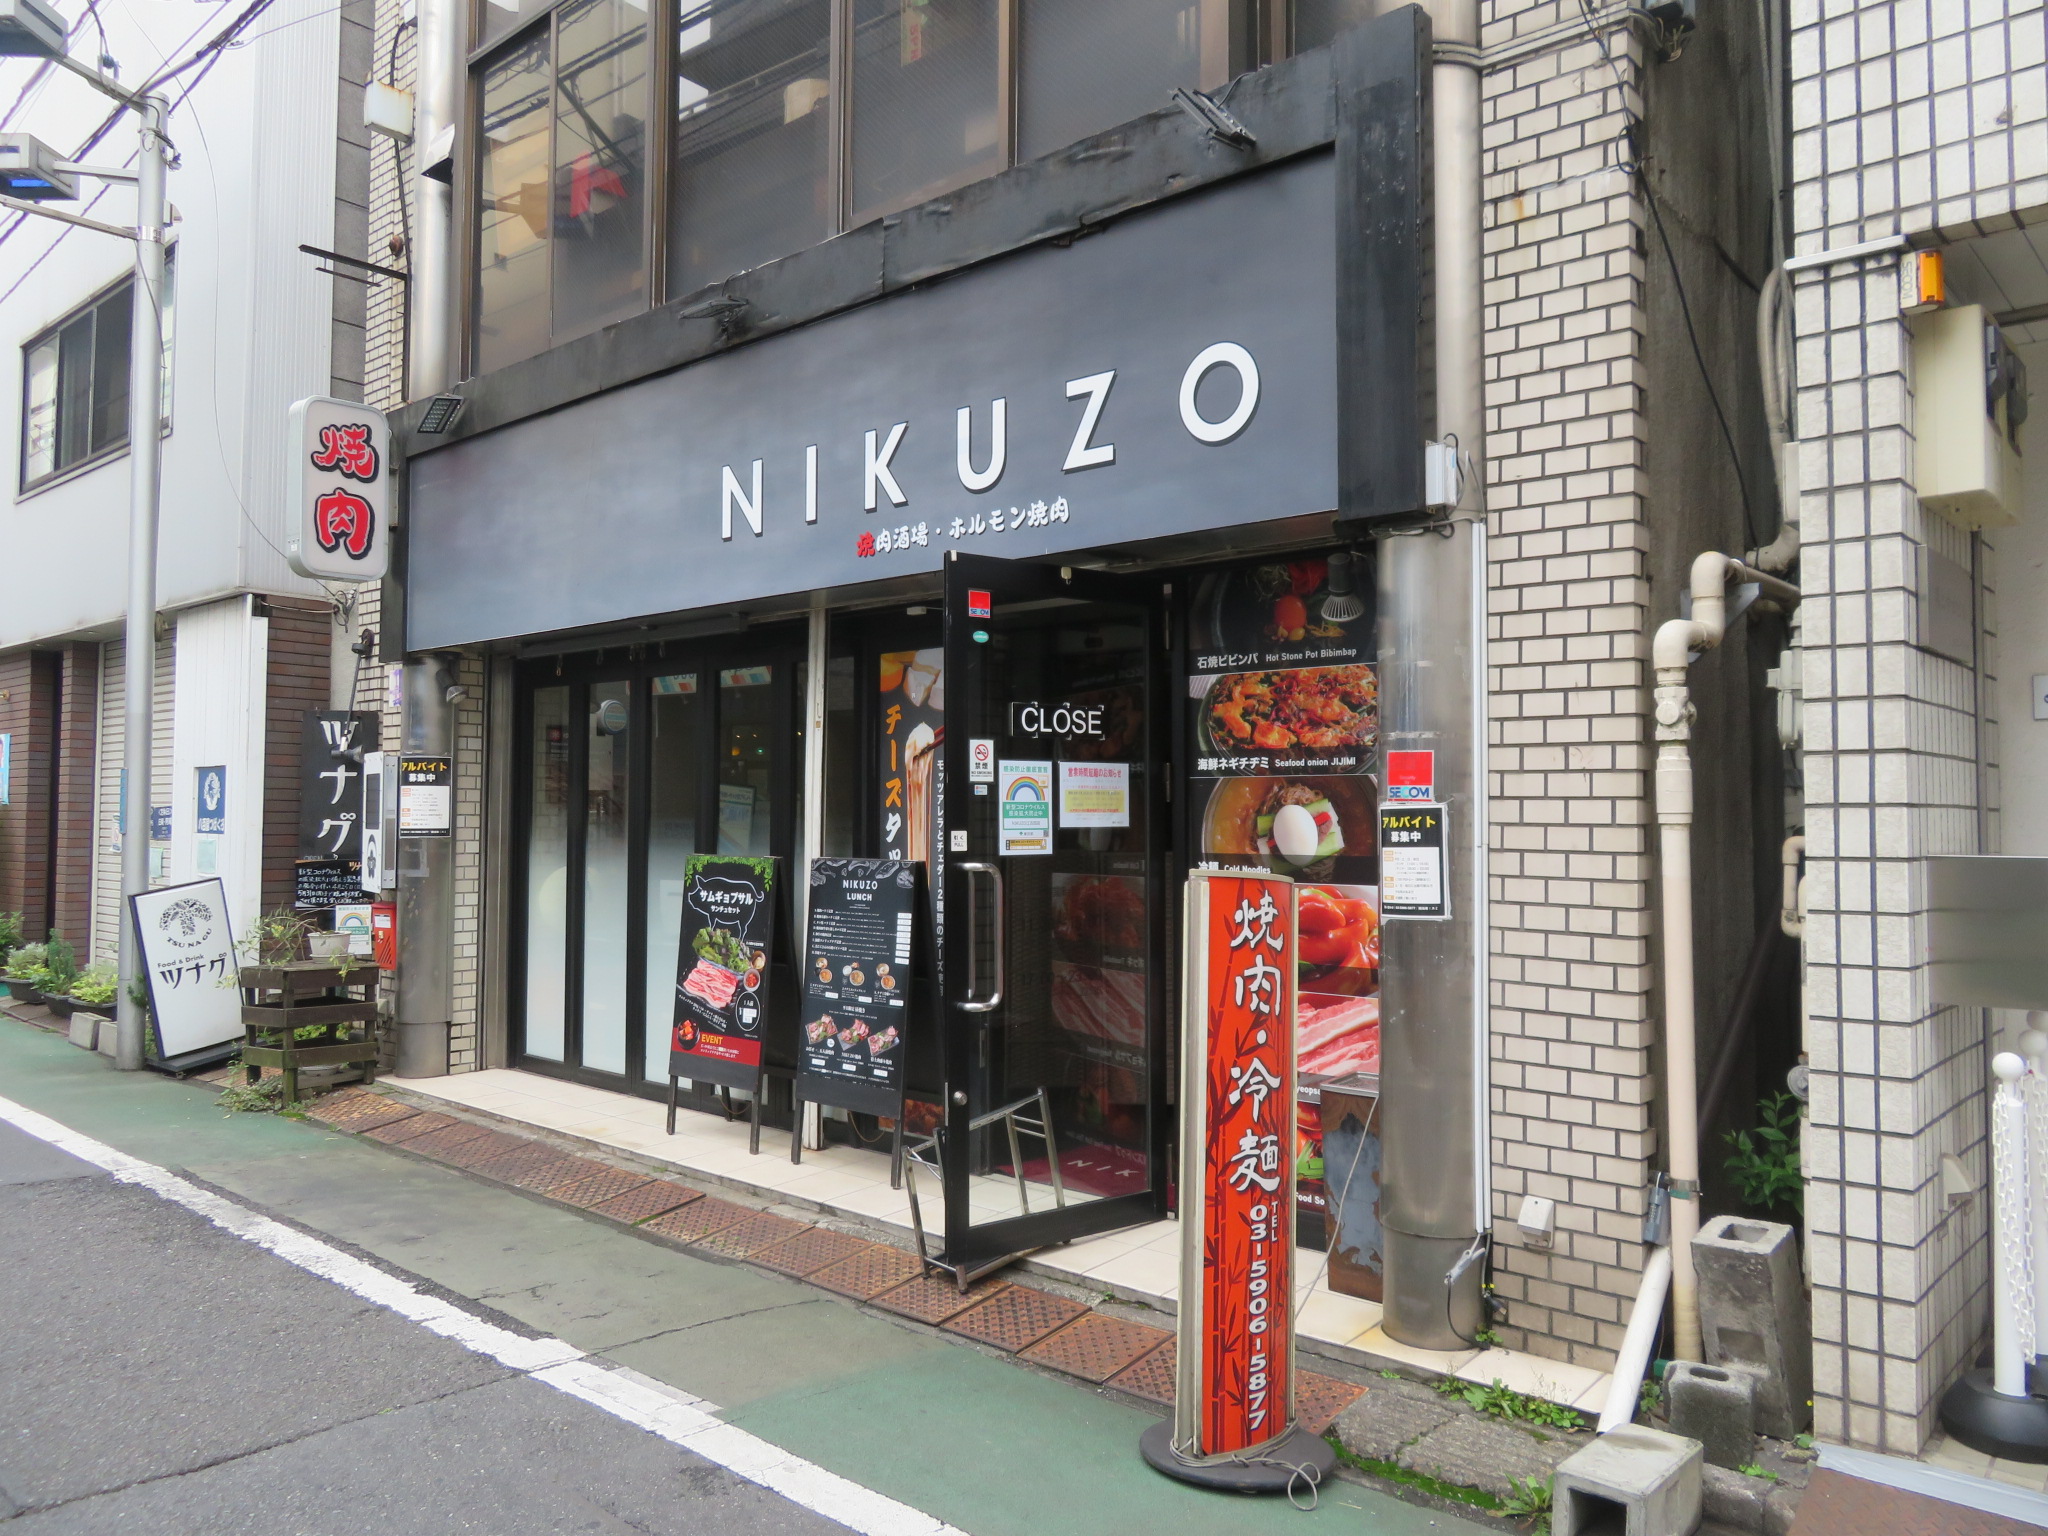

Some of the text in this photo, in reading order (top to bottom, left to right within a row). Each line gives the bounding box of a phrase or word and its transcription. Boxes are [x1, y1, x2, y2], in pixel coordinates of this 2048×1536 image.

[1902, 261, 1913, 299] SECOM
[721, 341, 1260, 541] NIKUZO
[311, 423, 379, 560] 焼肉
[856, 495, 1070, 557] 焼肉酒場・ホルモン焼肉
[1197, 653, 1259, 669] 石焼ビビンパ
[1265, 648, 1357, 662] Hot Stone Pot Bibimbap
[1021, 707, 1102, 734] CLOSE
[401, 761, 448, 772] アルバイト
[1274, 758, 1305, 767] Seafood
[1307, 758, 1329, 767] onion
[408, 773, 436, 783] 募集中
[1389, 786, 1430, 798] SECOM
[1382, 816, 1436, 829] アルバイト
[1390, 831, 1422, 843] 募集中
[842, 879, 878, 890] NIKUZO
[847, 892, 872, 901] LUNCH
[157, 960, 177, 968] Food
[185, 954, 204, 963] Drink
[159, 952, 227, 989] ツナグ
[701, 1034, 723, 1045] EVENT
[1271, 1201, 1279, 1242] TEL
[1248, 1204, 1269, 1430] 03-5906-5877
